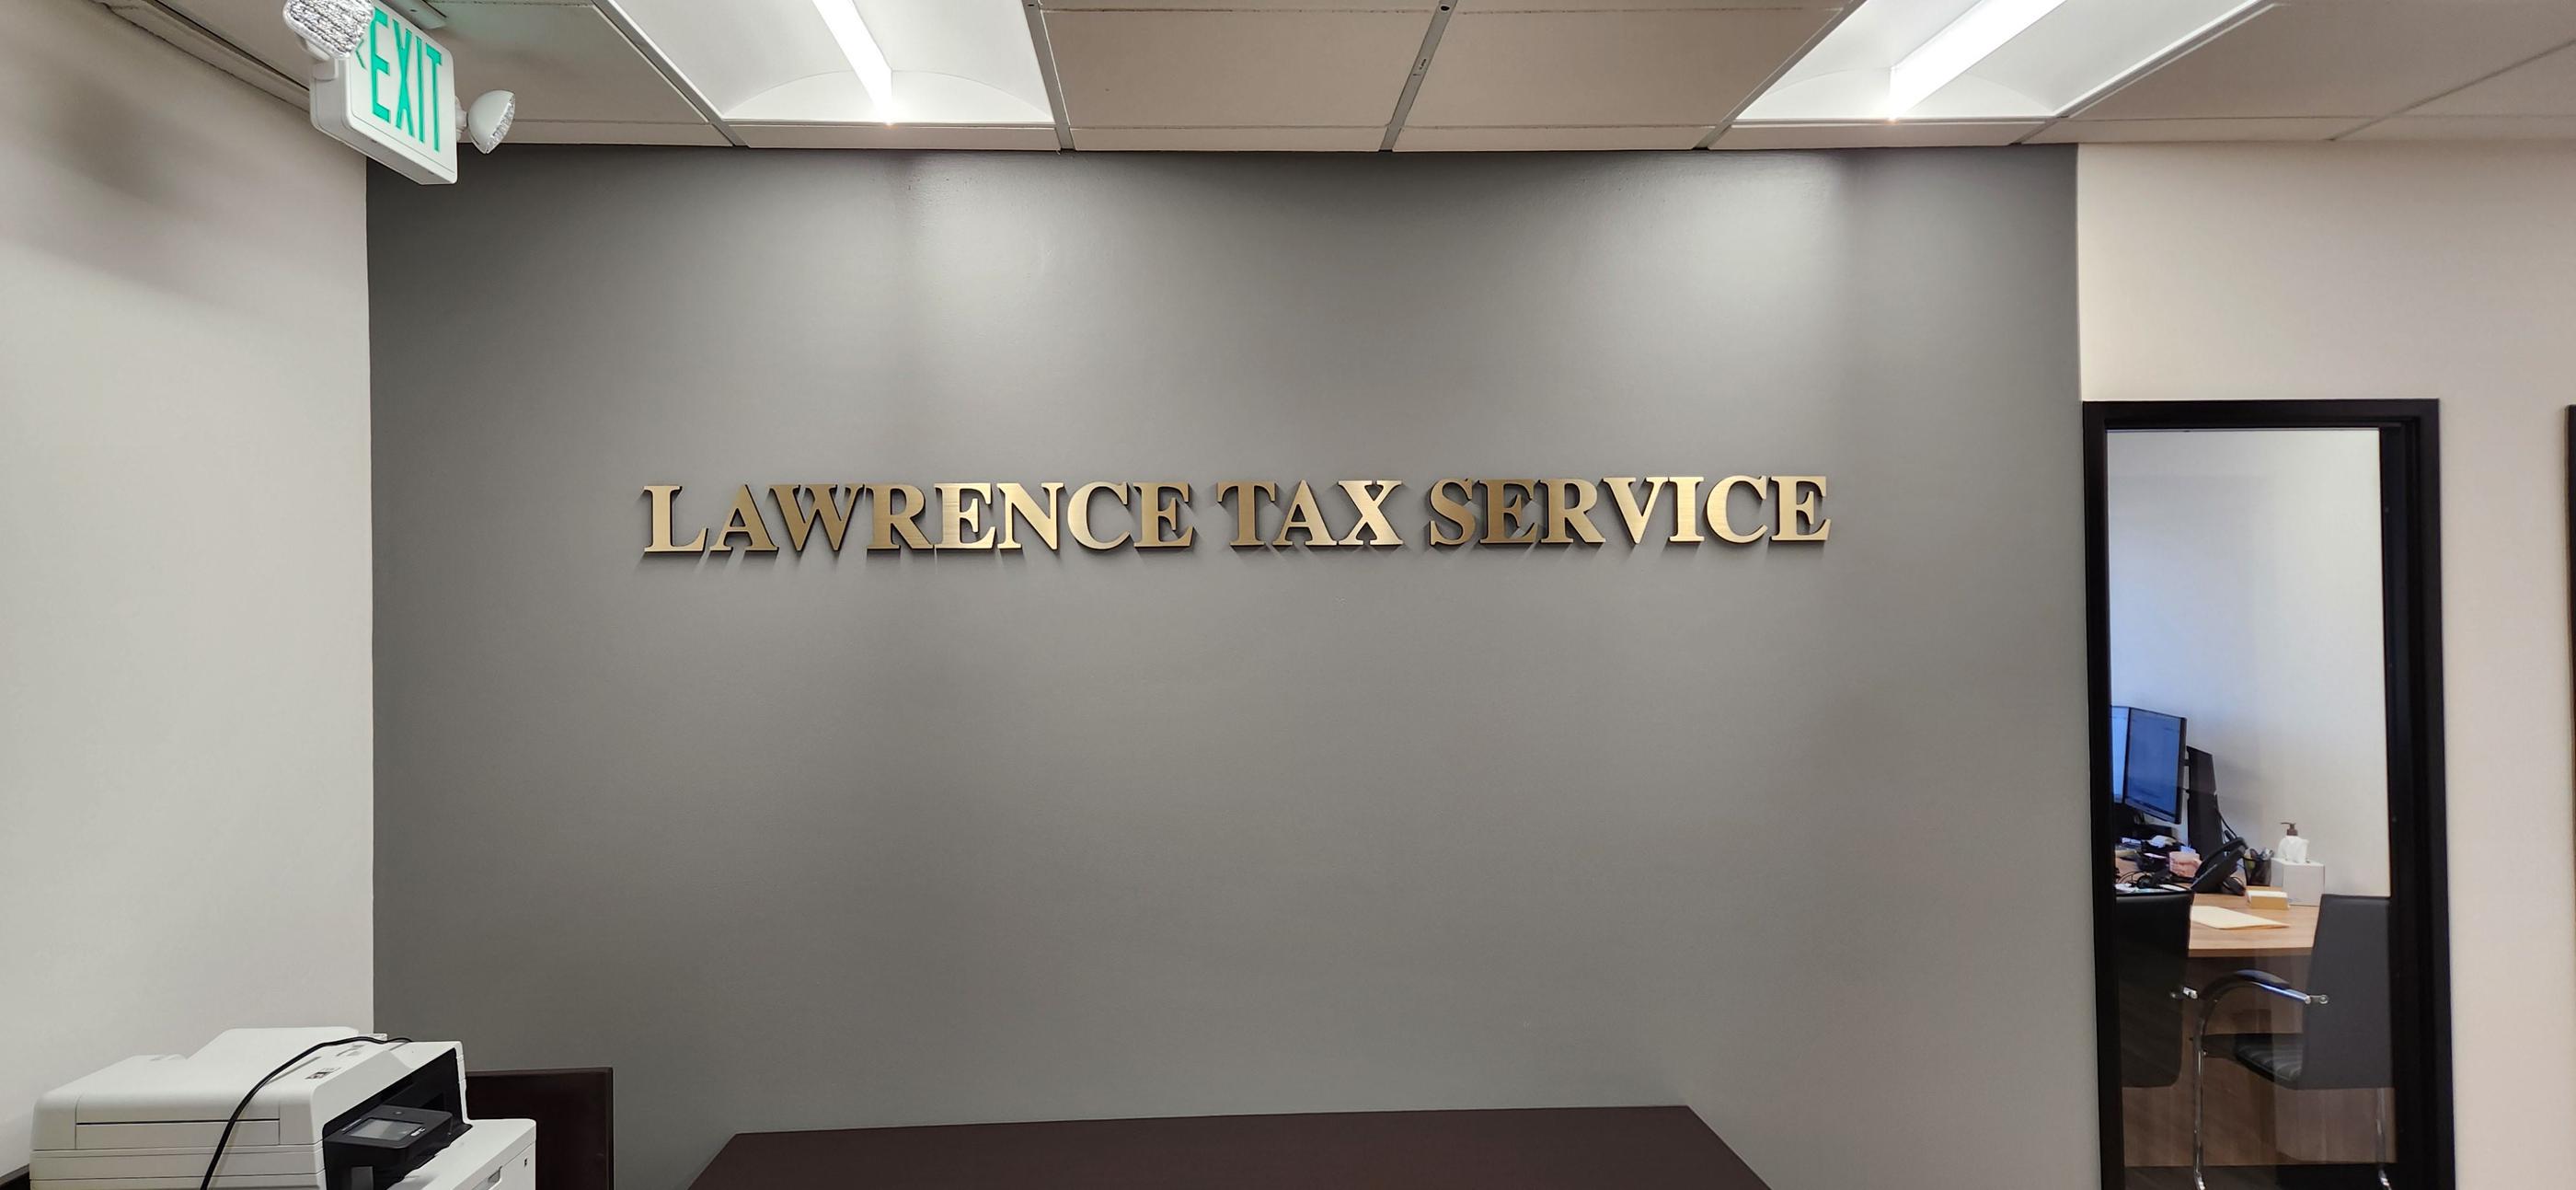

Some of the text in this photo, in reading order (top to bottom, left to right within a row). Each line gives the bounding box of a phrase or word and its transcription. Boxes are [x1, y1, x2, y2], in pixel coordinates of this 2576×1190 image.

[370, 7, 442, 152] EXIT
[644, 475, 1832, 552] LAWRENCE TAX SERVICE
